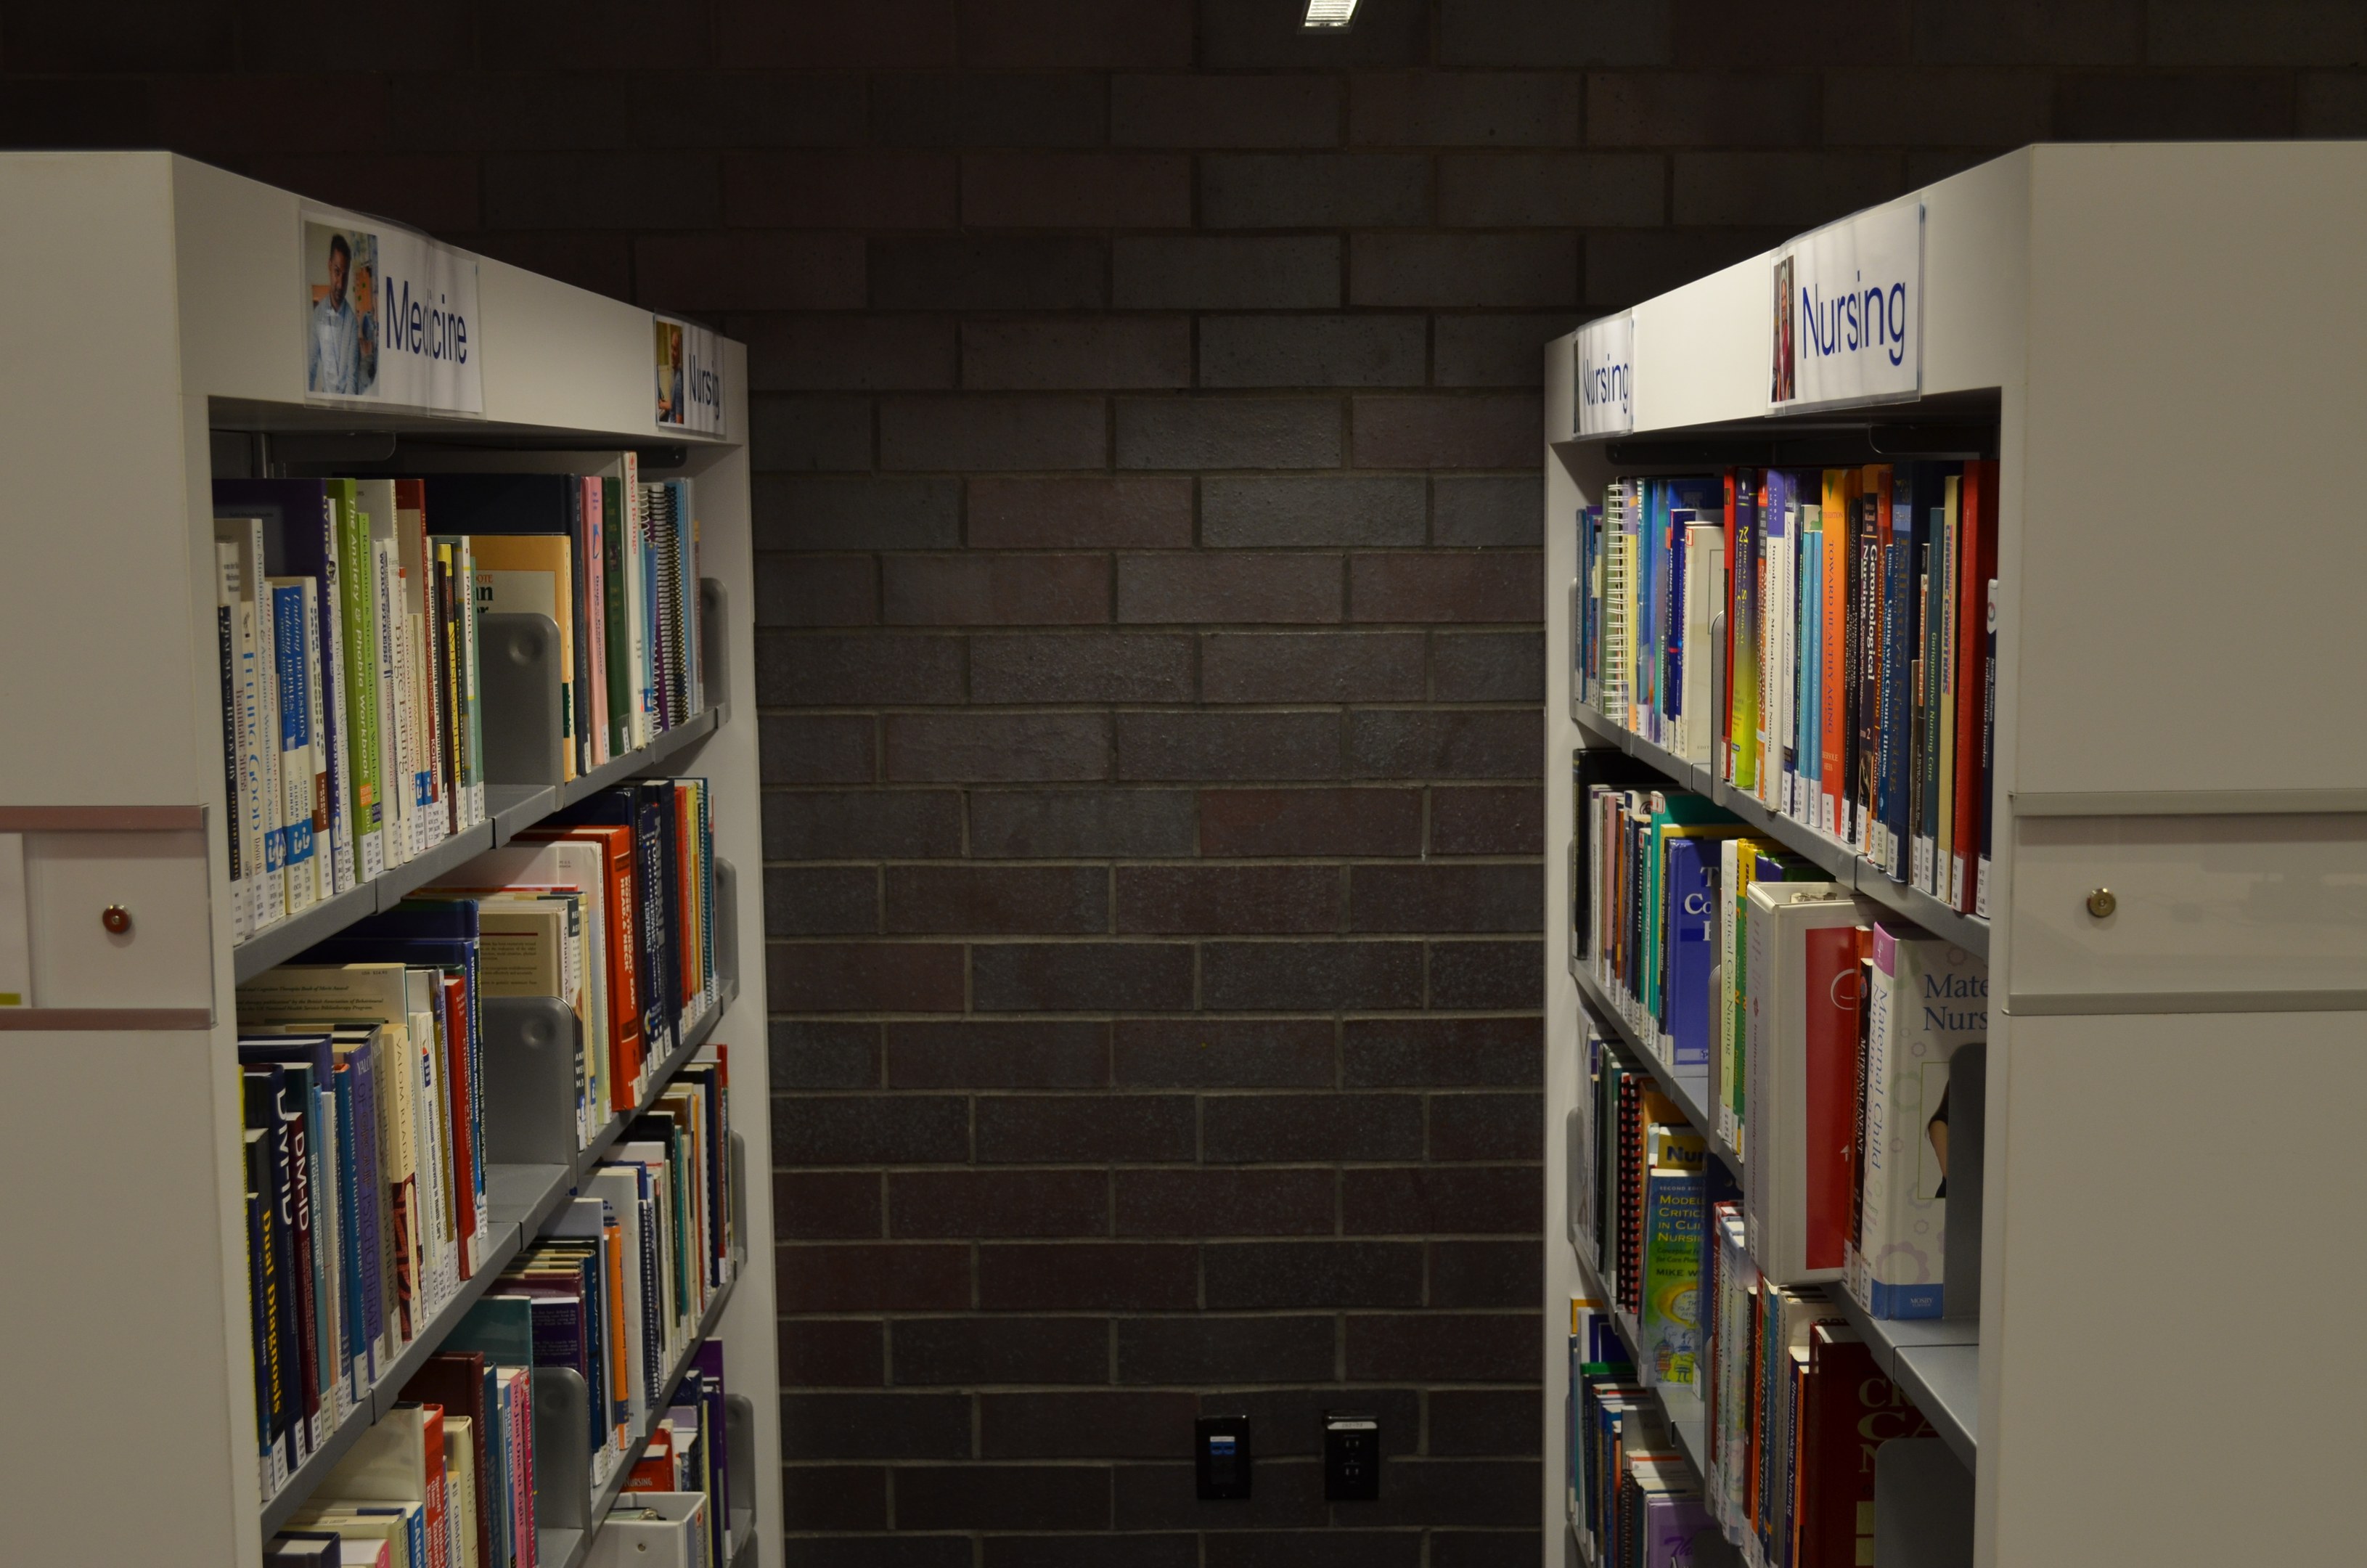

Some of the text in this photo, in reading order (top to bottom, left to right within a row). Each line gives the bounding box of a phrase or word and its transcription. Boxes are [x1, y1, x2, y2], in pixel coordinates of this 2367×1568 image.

[385, 276, 468, 364] Medicine
[1802, 271, 1906, 365] Nursing
[1583, 354, 1630, 413] Nursing
[350, 534, 360, 601] Anxiety
[360, 695, 369, 778] Workbook
[1867, 544, 1877, 681] Gerontological
[237, 688, 245, 749] Traumatic
[245, 653, 261, 830] FEELING GOOD
[394, 626, 407, 774] Binge Eating
[1889, 679, 1902, 793] Nursing
[1870, 983, 1879, 1073] Nursing
[1923, 1006, 1987, 1031] Nurs
[1924, 973, 1988, 998] Mate
[1872, 989, 1887, 1169] Maternal Child
[295, 1131, 308, 1231] DM-ID
[311, 1154, 315, 1164] IN
[1659, 1195, 1702, 1205] MODEL
[358, 1084, 377, 1339] OF GROUP PSYCHOTHERAPY
[382, 1175, 394, 1315] PSYCHOTHERAPY
[1657, 1233, 1702, 1243] NURSI
[1659, 1207, 1701, 1217] CRITIC
[263, 1209, 282, 1415] Dual Diagnosis
[518, 1474, 523, 1486] in
[624, 1477, 653, 1487] NURSING
